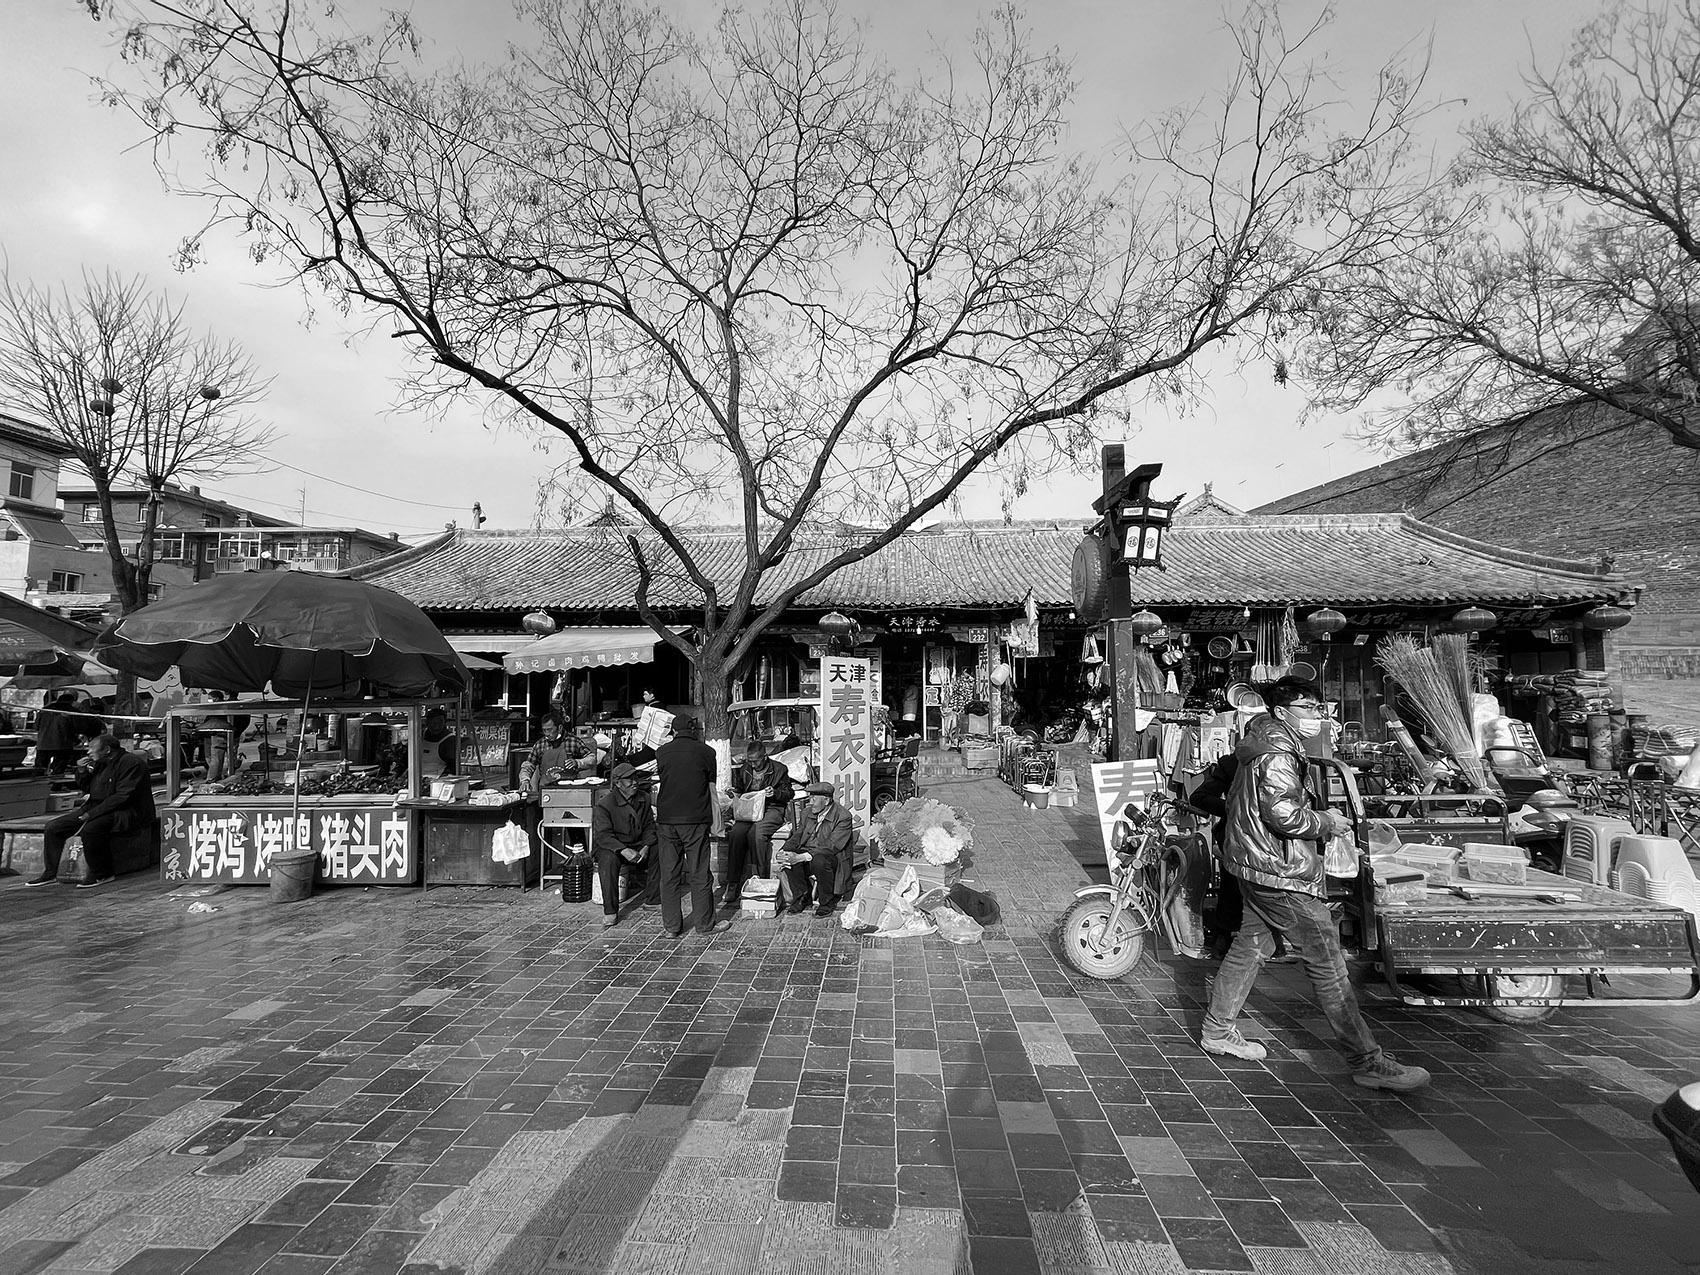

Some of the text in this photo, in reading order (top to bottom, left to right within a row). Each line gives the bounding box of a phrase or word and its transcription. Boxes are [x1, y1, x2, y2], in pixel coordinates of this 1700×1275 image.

[972, 634, 985, 642] 232
[1554, 635, 1569, 643] 240
[829, 664, 867, 684] 天津
[163, 812, 186, 881] 北京
[188, 812, 246, 879] 烤鸡
[320, 811, 410, 879] 猪头肉
